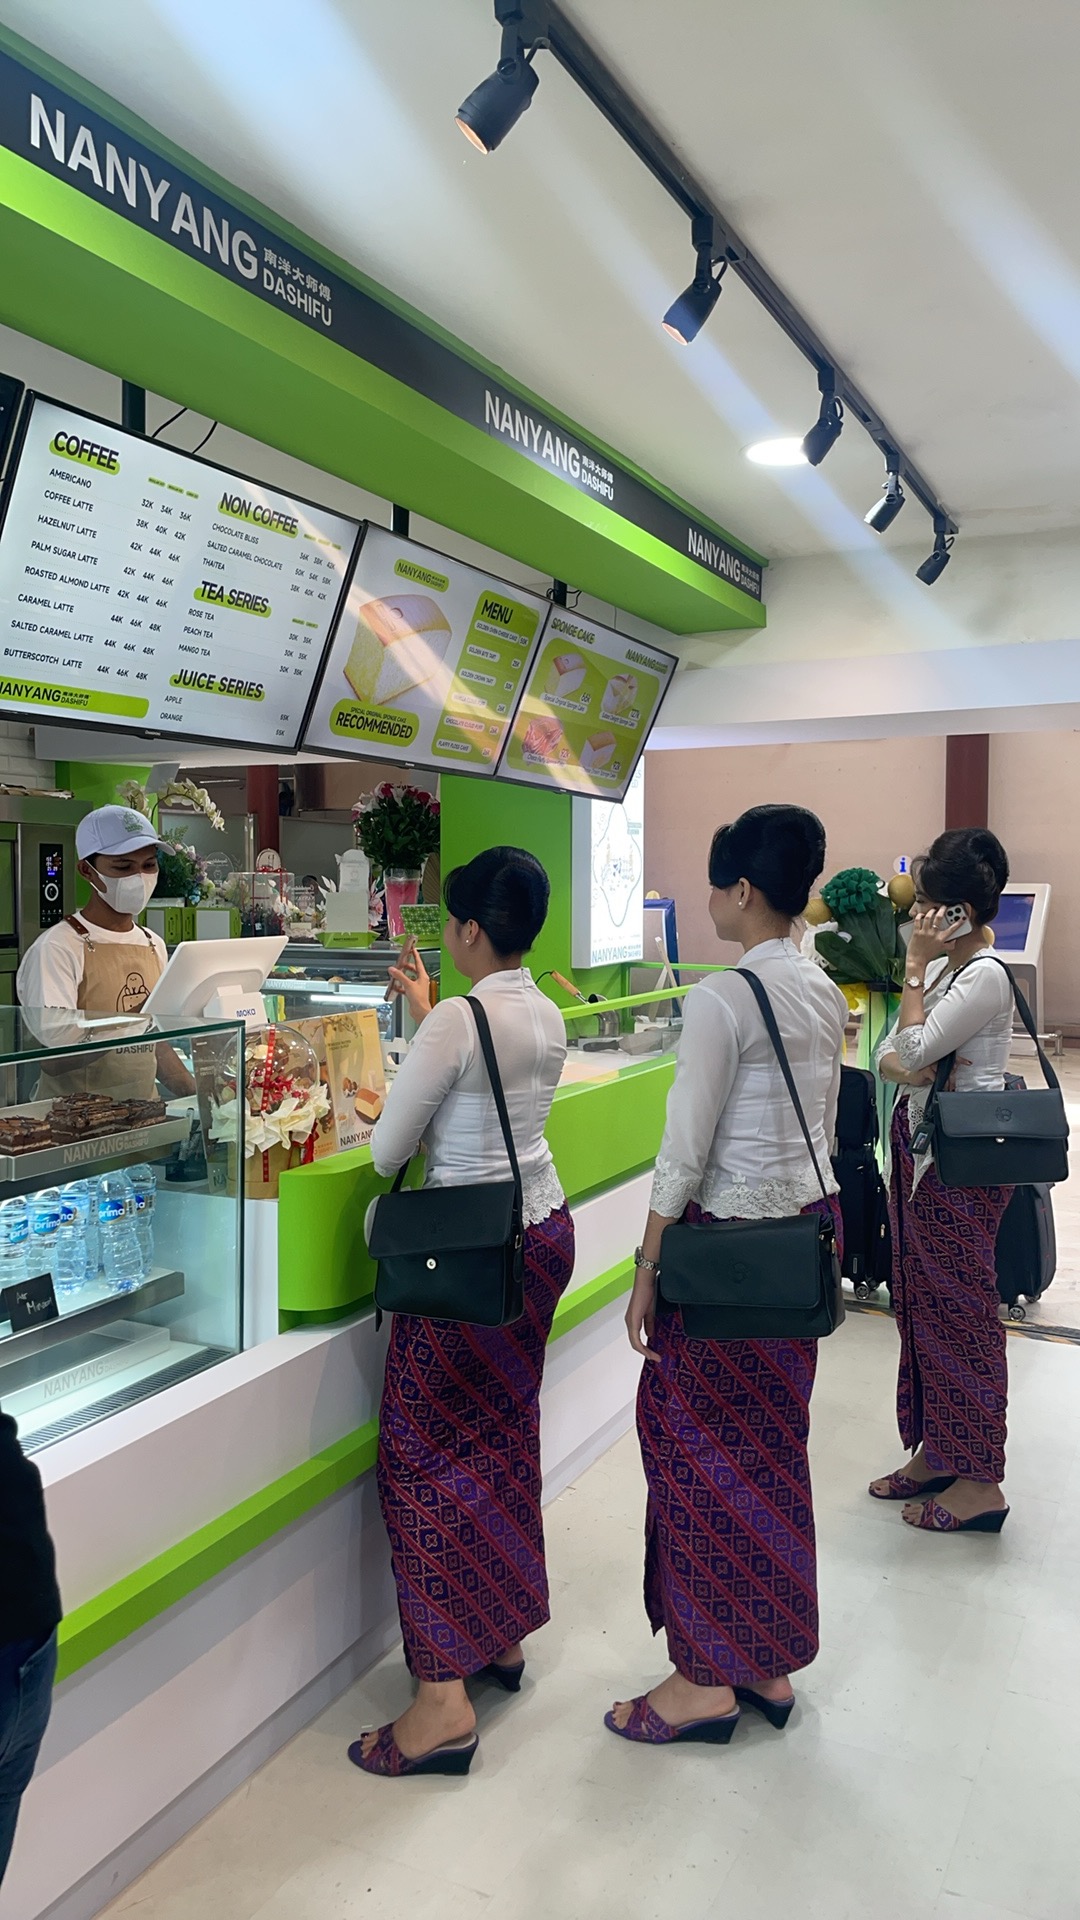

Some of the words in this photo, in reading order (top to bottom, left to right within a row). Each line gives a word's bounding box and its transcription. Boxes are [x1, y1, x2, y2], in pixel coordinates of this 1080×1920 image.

[30, 93, 258, 280] NANYANG
[263, 267, 332, 327] DASHIFU
[485, 389, 580, 479] NANYANG
[54, 431, 119, 471] COFFEE
[49, 468, 92, 489] AMERICANO
[581, 468, 614, 501] DASHIFU
[44, 489, 71, 505] COFFEE
[72, 498, 94, 512] LATTE
[141, 498, 154, 509] 32K
[160, 505, 173, 516] 34K
[179, 511, 191, 522] 36K
[220, 492, 251, 518] NON
[252, 504, 299, 535] COFFEE
[37, 514, 75, 533] HAZELNUT
[76, 525, 97, 539] LATTE
[136, 518, 149, 529] 38K
[155, 524, 168, 535] 40K
[174, 530, 187, 541] 42K
[212, 522, 244, 541] CHOCOLATE
[244, 533, 259, 545] BLISS
[31, 540, 52, 553] PALM
[52, 546, 76, 560] SUGAR
[77, 552, 98, 566] LATTE
[130, 541, 143, 552] 42K
[149, 547, 162, 557] 44K
[168, 553, 181, 563] 46K
[207, 540, 227, 553] SALTED
[228, 546, 252, 562] CARAMEL
[253, 555, 283, 571] CHOCOLATE
[688, 527, 741, 583] NANYANG
[24, 565, 58, 581] ROASTED
[59, 574, 89, 589] ALMOND
[90, 582, 111, 594] LATTE
[123, 566, 137, 576] 42K
[142, 571, 156, 581] 44K
[161, 576, 174, 586] 46K
[397, 562, 432, 584] NANYANG
[17, 593, 52, 608] CARAMEL
[53, 602, 74, 613] LATTE
[117, 589, 130, 599] 42K
[136, 594, 149, 603] 44K
[155, 598, 168, 608] 46K
[200, 580, 224, 602] TEA
[227, 588, 270, 614] SERIES
[188, 608, 203, 619] ROSE
[204, 611, 215, 621] TEA
[481, 598, 514, 624] MENU
[10, 620, 38, 632] SALTED
[39, 625, 72, 640] CARAMEL
[73, 632, 94, 643] LATTE
[110, 614, 124, 624] 44K
[130, 618, 143, 628] 46K
[149, 622, 162, 632] 48K
[183, 625, 202, 637] PEACH
[202, 629, 214, 639] TEA
[551, 617, 579, 636] SPONGE
[577, 627, 596, 645] CAKE
[3, 647, 59, 665] BUTTERSCOTCH
[62, 658, 83, 669] LATTE
[104, 638, 117, 648] 44K
[123, 643, 136, 652] 46K
[142, 646, 155, 656] 48K
[178, 643, 200, 655] MANGO
[200, 648, 211, 657] TEA
[97, 665, 110, 674] 44K
[116, 668, 130, 677] 46K
[135, 672, 148, 681] 48K
[174, 668, 216, 691] JUICE
[218, 676, 264, 699] SERIES
[60, 696, 89, 706] DASHIFU
[164, 695, 183, 705] APPLE
[160, 712, 183, 722] ORANGE
[335, 711, 413, 739] RECOMMENDED
[592, 945, 628, 964] NANYANG
[115, 1043, 155, 1054] DASHIFU
[63, 1138, 124, 1164] NANYANG
[43, 1361, 104, 1399] NANYANG
